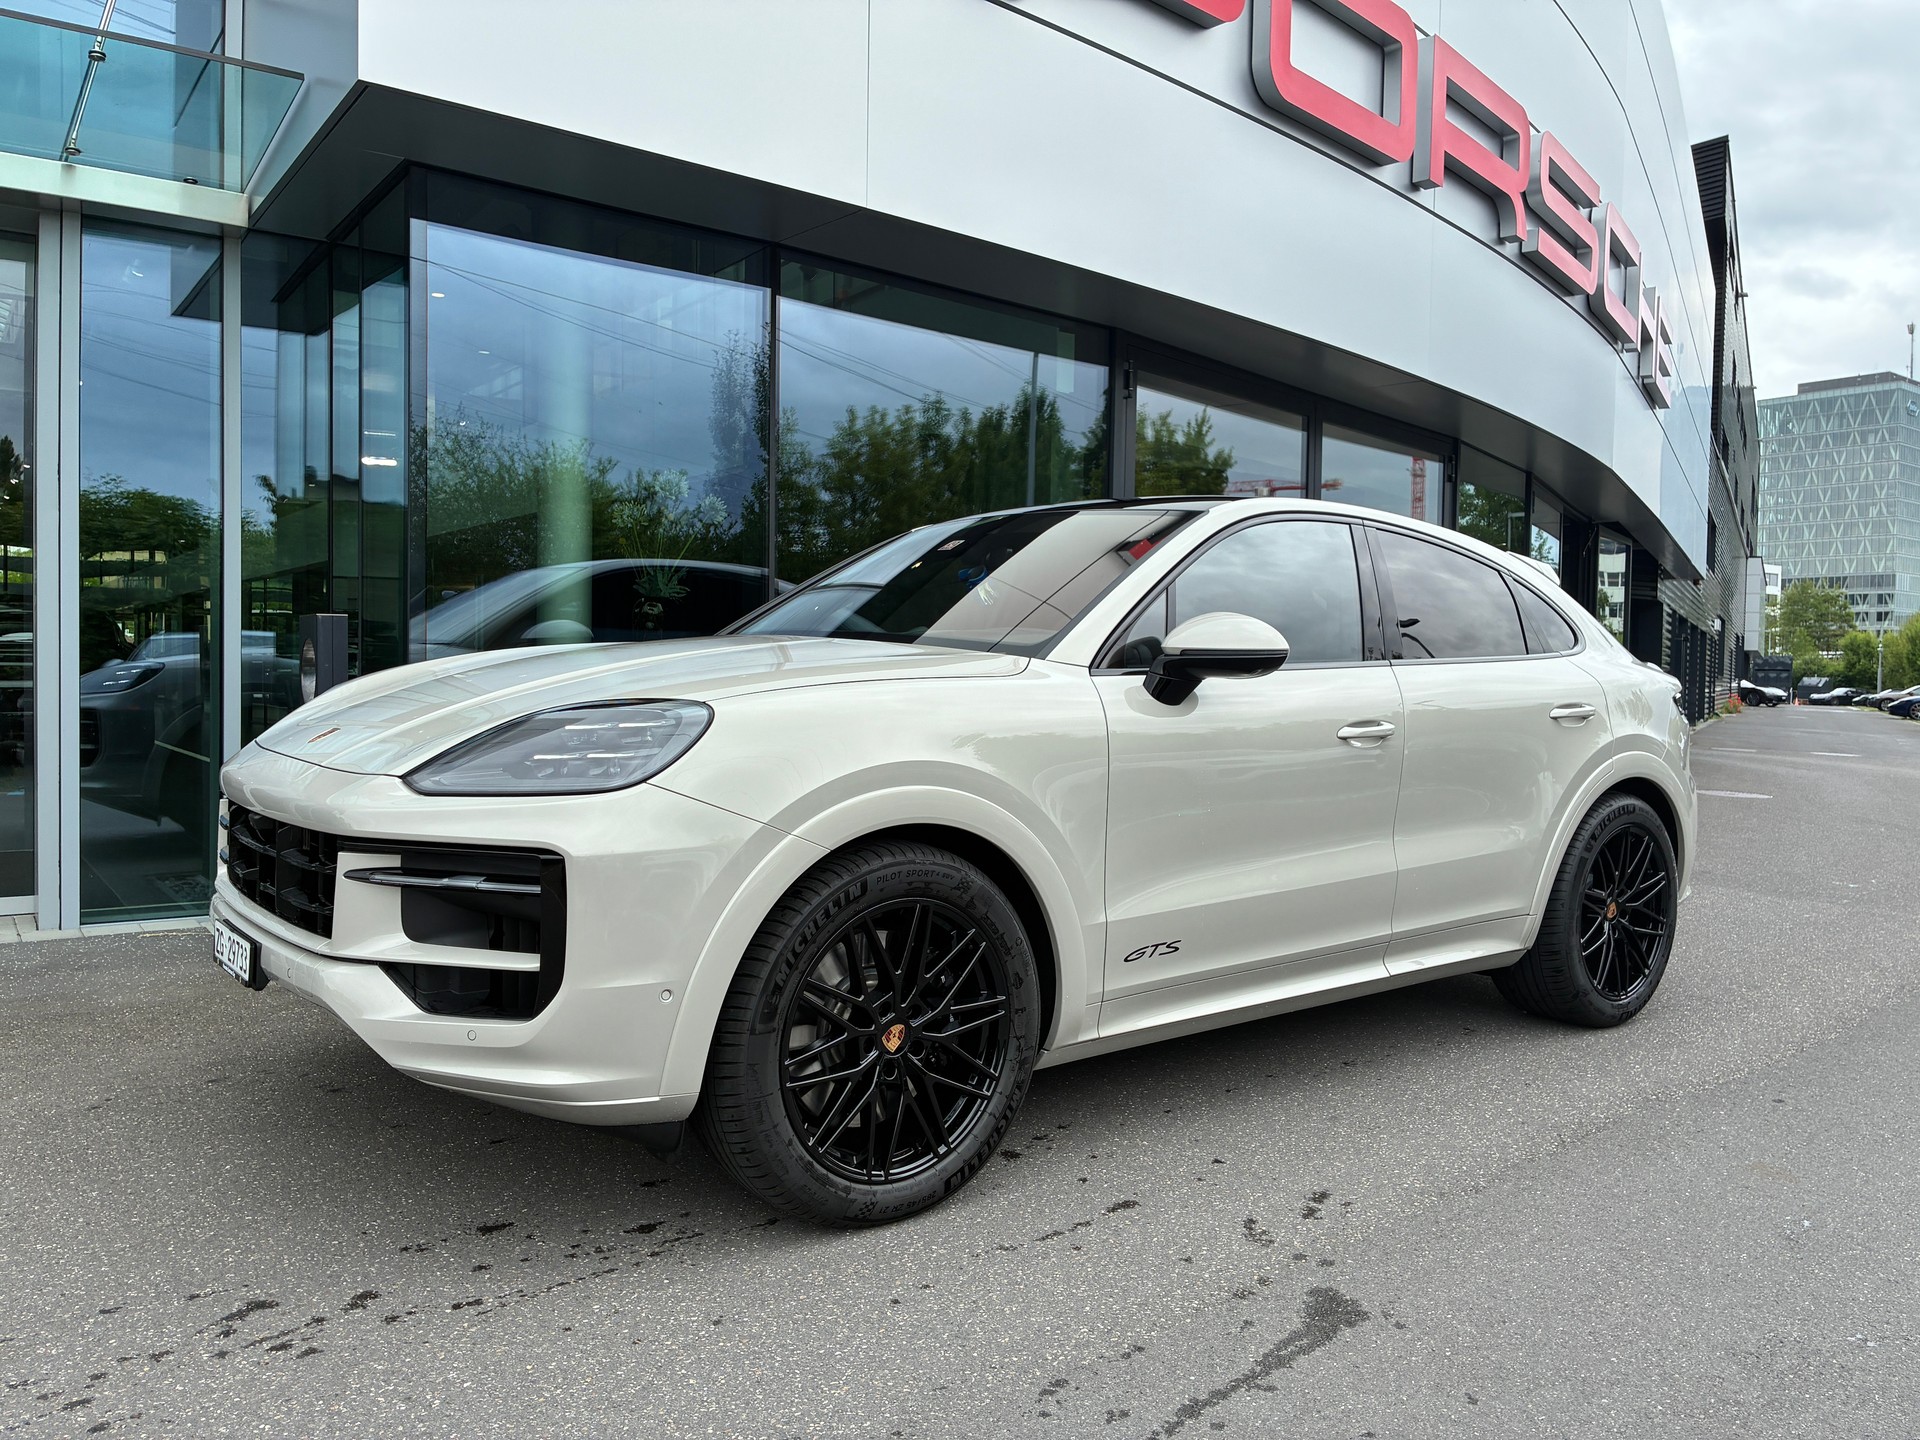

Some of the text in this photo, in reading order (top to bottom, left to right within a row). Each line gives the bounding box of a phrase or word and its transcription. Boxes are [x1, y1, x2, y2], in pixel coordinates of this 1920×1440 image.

[1150, 0, 1674, 410] ORSCHE
[876, 871, 902, 885] PILOT
[905, 869, 936, 878] SPORT
[775, 881, 862, 988] MICHELIN
[1123, 939, 1182, 963] GTS
[949, 1087, 1022, 1189] MICHELIN
